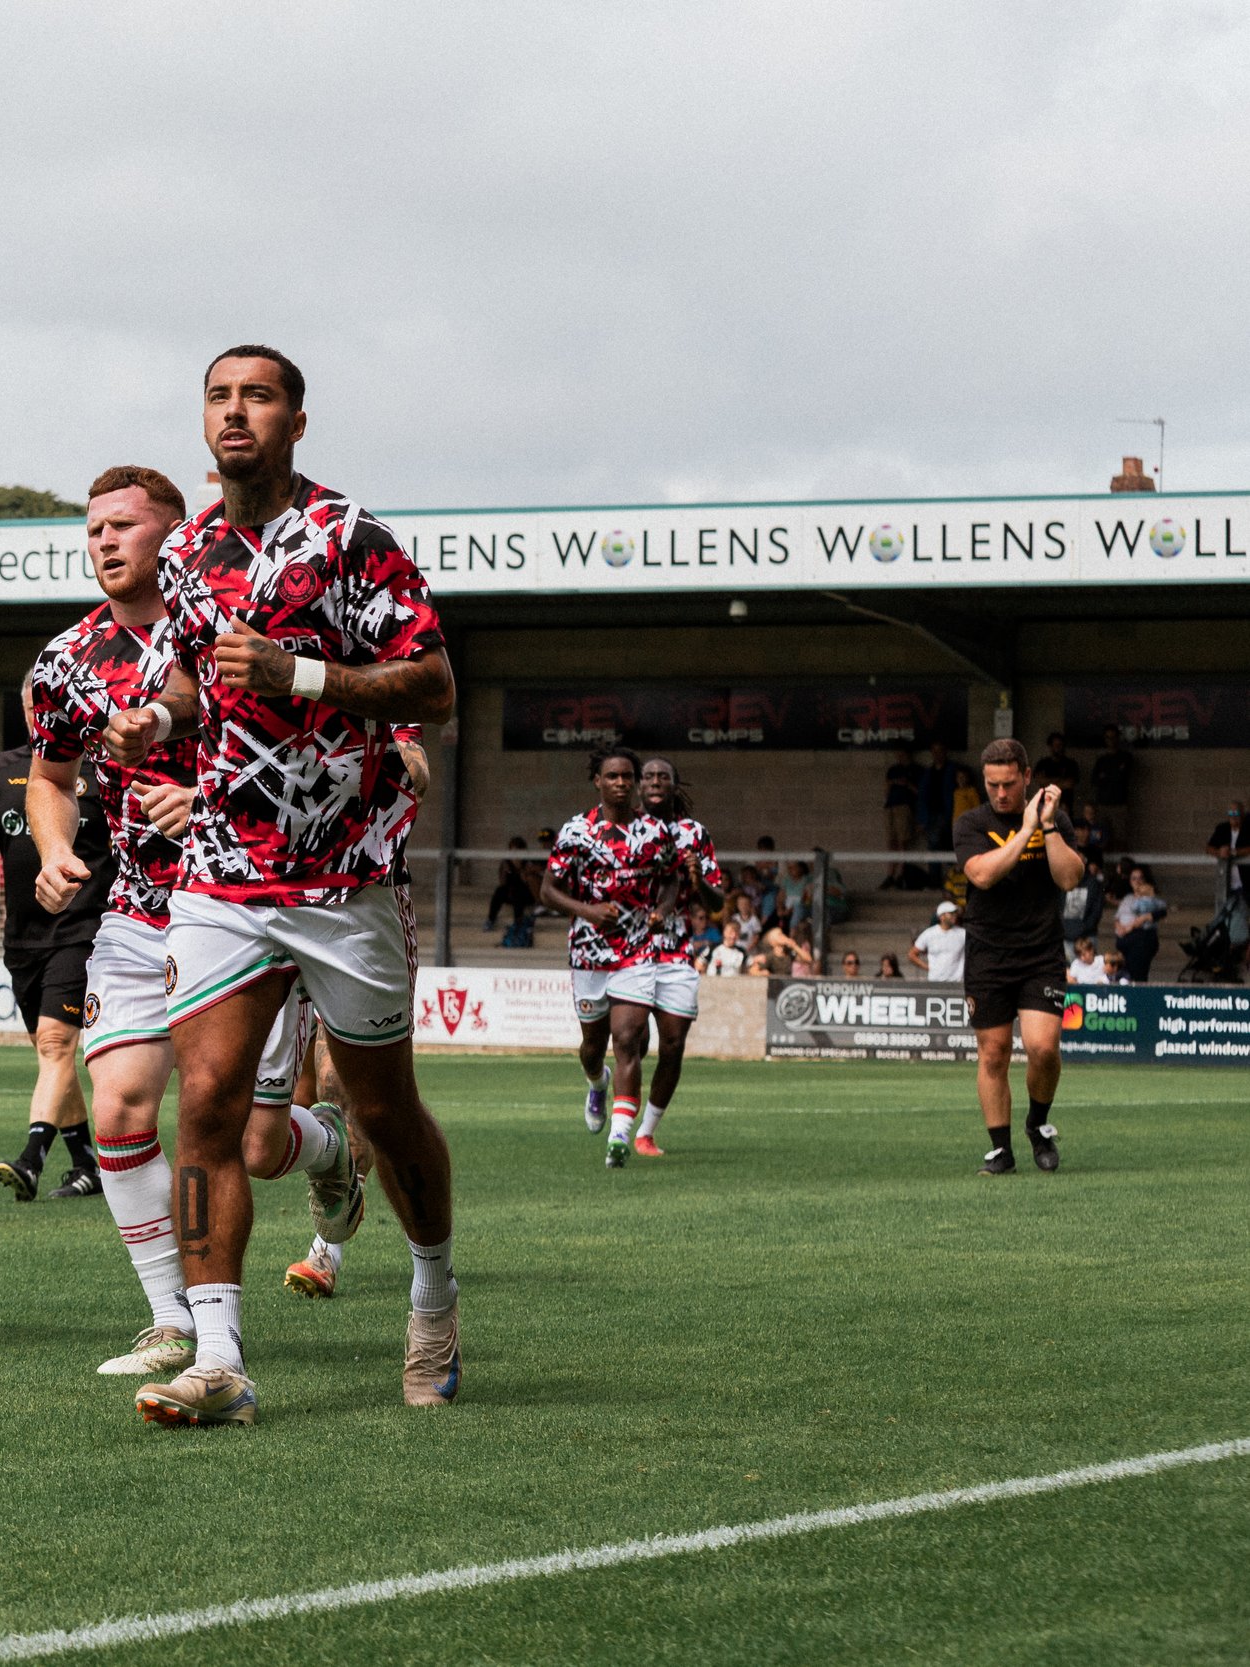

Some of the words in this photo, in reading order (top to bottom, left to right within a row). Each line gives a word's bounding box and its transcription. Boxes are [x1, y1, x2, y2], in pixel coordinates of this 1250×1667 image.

[413, 534, 526, 571] LENS
[552, 527, 790, 568] WOLLENS
[817, 521, 1067, 563] WOLLENS
[1095, 517, 1247, 559] WOLL
[1118, 725, 1190, 742] OMPS
[816, 983, 874, 996] TORQUAY
[1085, 993, 1127, 1013] Built
[1164, 995, 1232, 1010] Traditional
[1235, 997, 1249, 1011] to
[369, 1012, 403, 1028] VX3
[1084, 1013, 1137, 1032] Green
[1159, 1017, 1186, 1034] high
[1155, 1039, 1196, 1056] glazed
